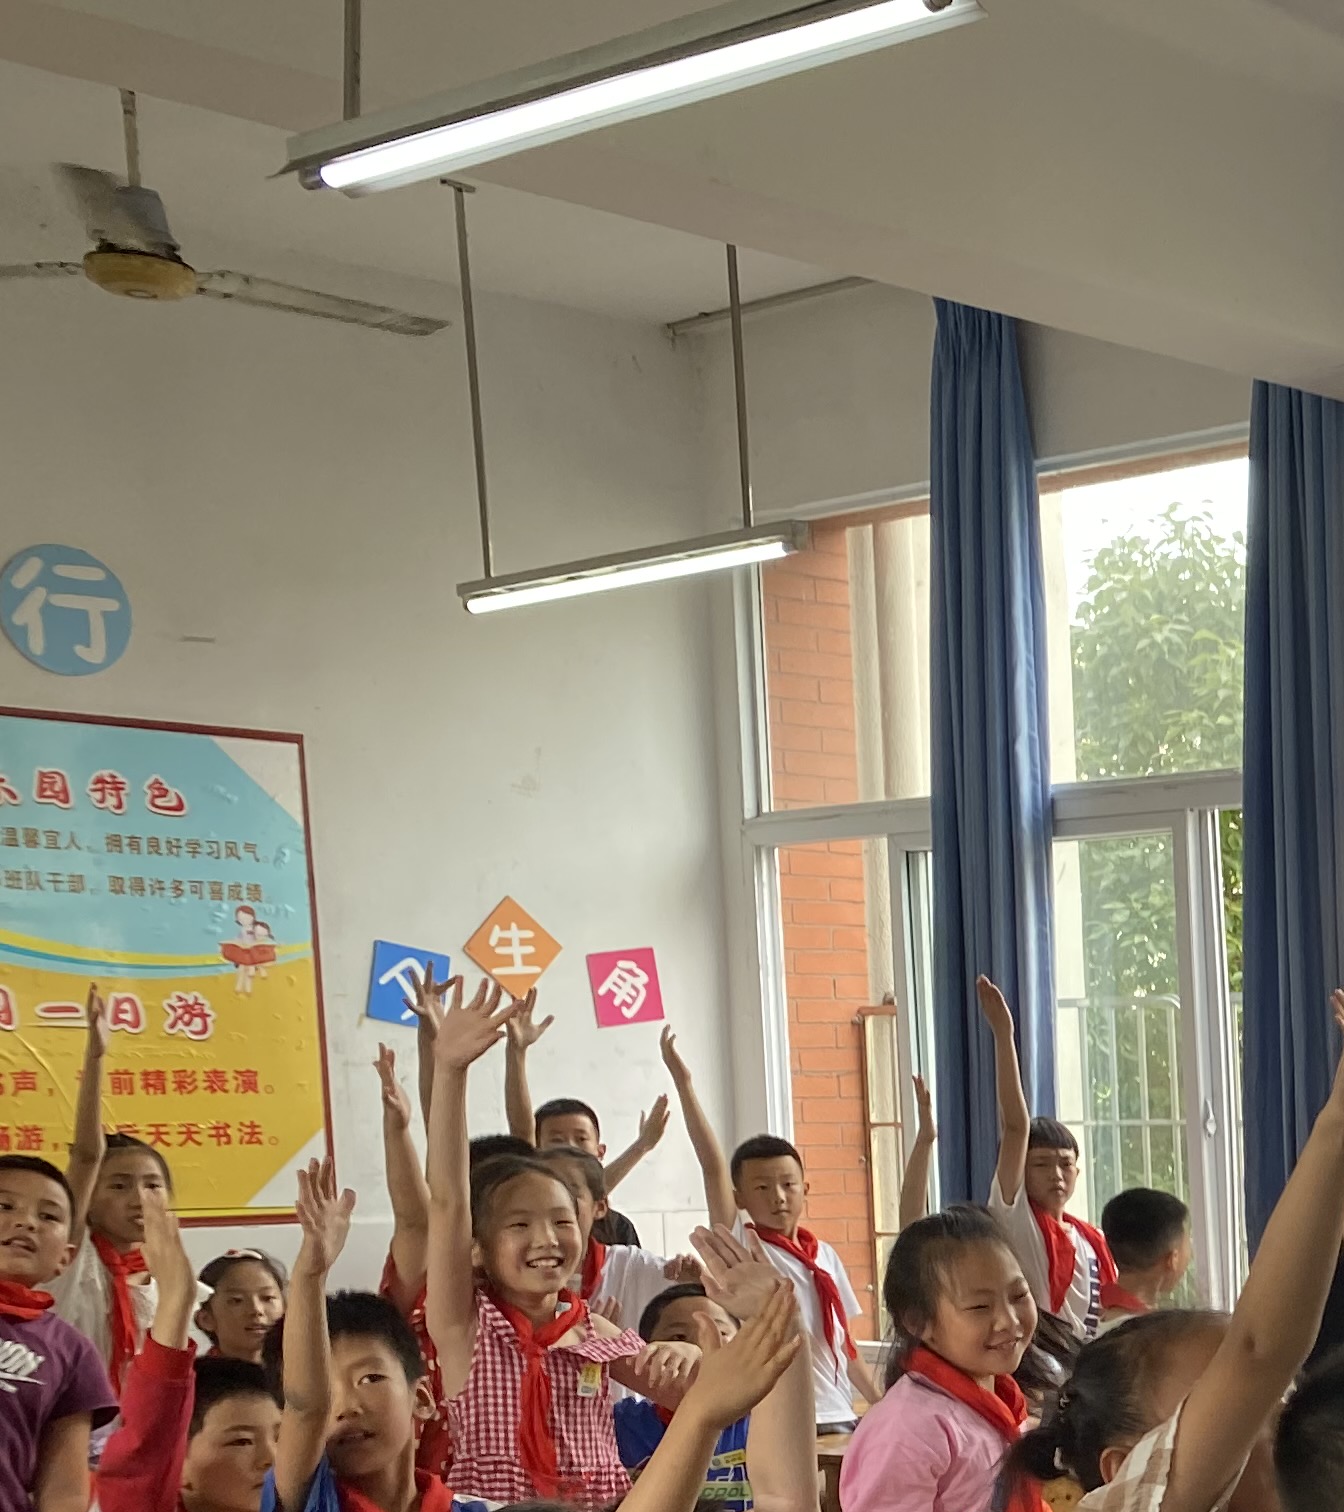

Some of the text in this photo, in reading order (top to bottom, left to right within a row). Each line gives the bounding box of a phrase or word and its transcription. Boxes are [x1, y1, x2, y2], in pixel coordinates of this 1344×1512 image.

[10, 556, 120, 664] 行
[0, 768, 187, 815] 园特色
[0, 1068, 276, 1097] 声，前精彩表演。
[702, 1486, 749, 1499] COOL
